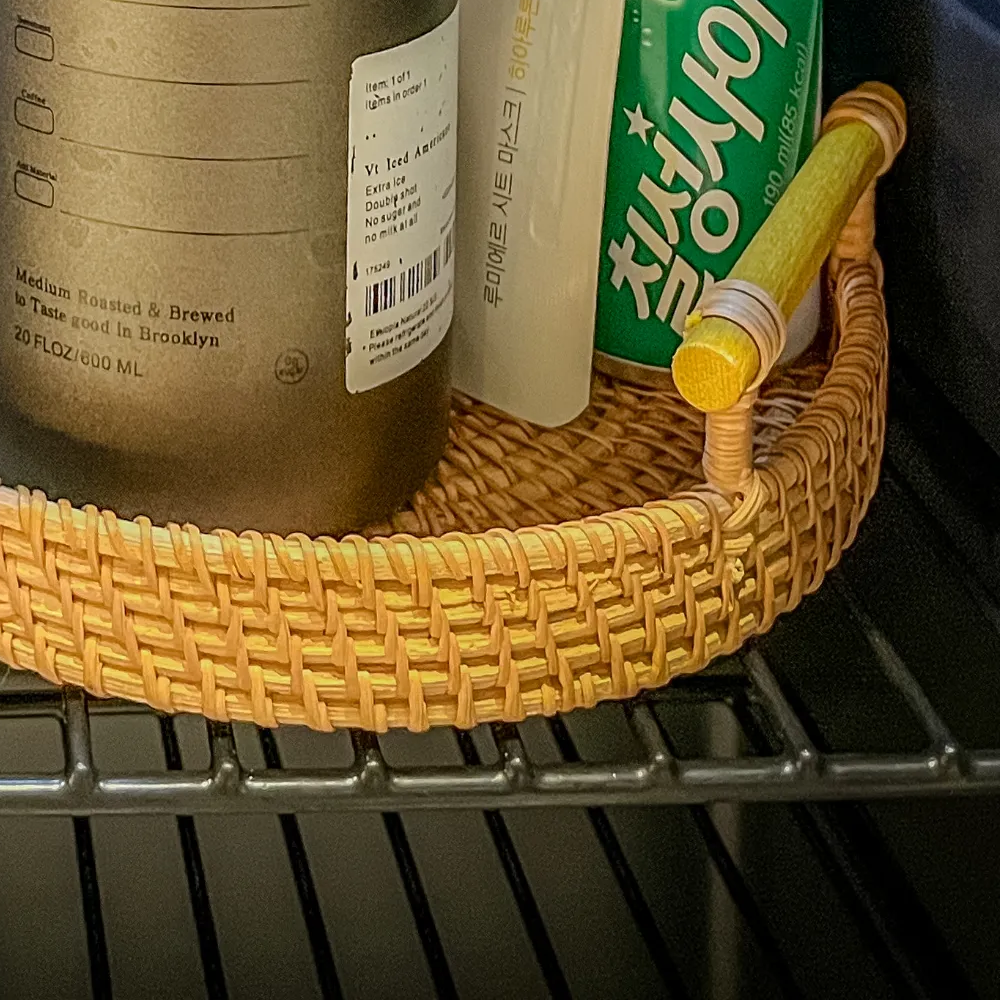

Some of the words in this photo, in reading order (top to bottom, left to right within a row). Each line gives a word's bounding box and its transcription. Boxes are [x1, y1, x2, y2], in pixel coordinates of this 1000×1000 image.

[397, 70, 405, 84] of
[365, 95, 391, 110] Items
[393, 91, 401, 102] in
[497, 99, 522, 166] 마스크
[386, 150, 409, 171] Iced
[365, 181, 391, 197] Extra
[400, 183, 418, 200] shot
[492, 171, 513, 217] 시트
[763, 169, 784, 207] 190
[365, 216, 379, 228] No
[364, 232, 377, 244] no
[484, 222, 507, 308] 루미에르
[15, 266, 71, 300] Medium
[78, 288, 142, 316] Roasted
[147, 302, 161, 319] &
[169, 304, 235, 324] Brewed
[14, 291, 27, 307] to
[30, 297, 67, 323] Taste
[71, 315, 110, 336] good
[140, 325, 220, 349] Brooklyn
[14, 324, 31, 347] 20
[116, 358, 144, 378] ML
